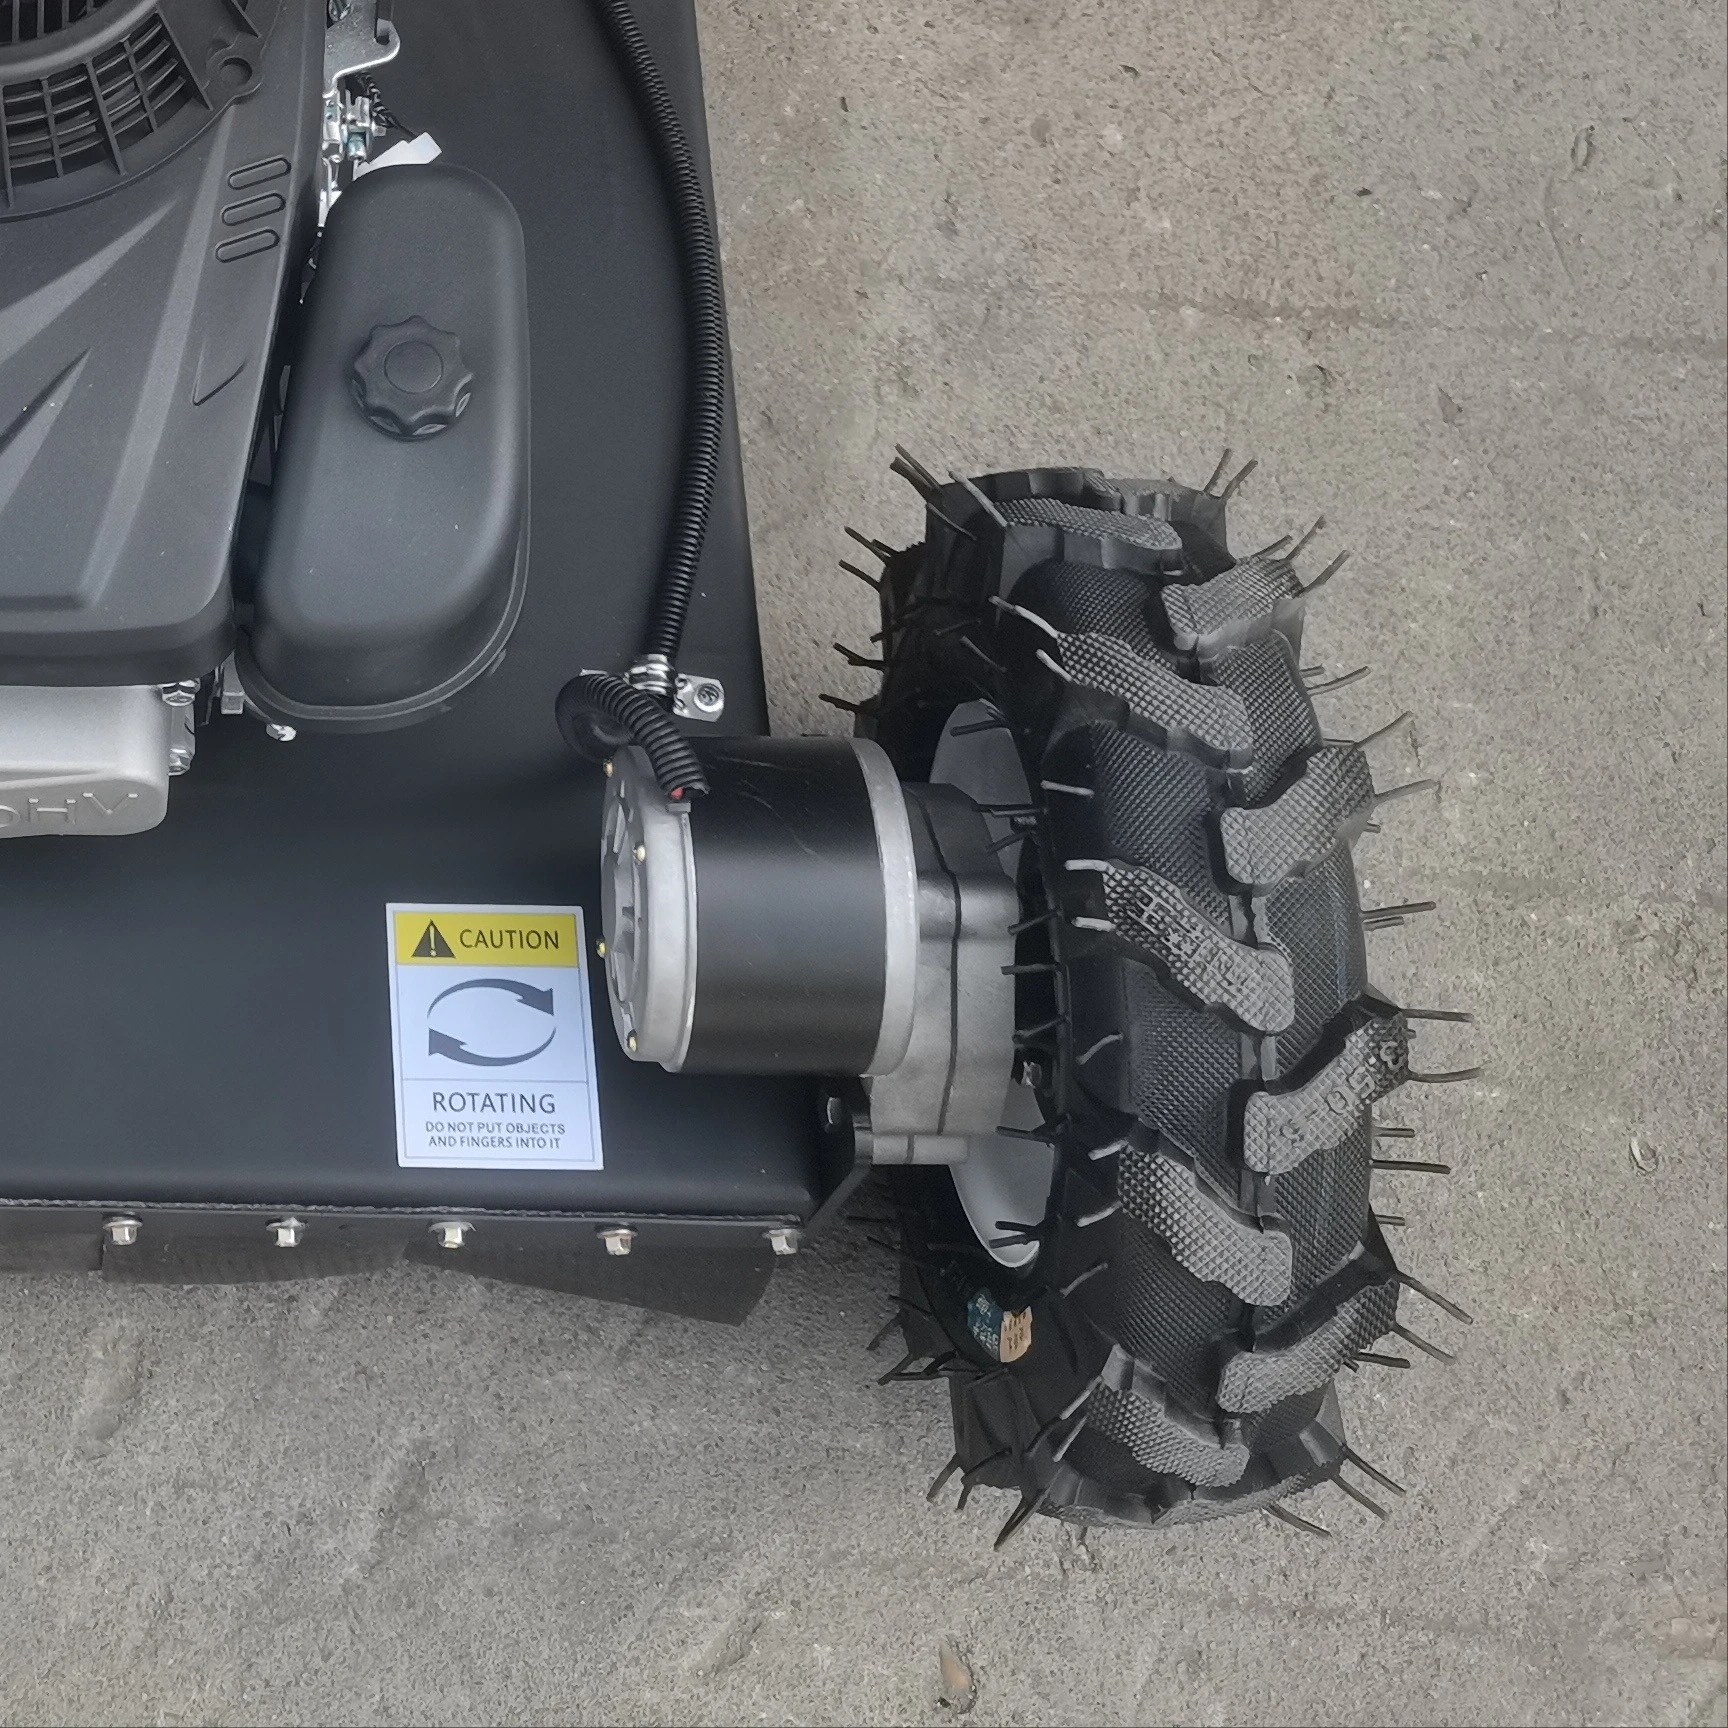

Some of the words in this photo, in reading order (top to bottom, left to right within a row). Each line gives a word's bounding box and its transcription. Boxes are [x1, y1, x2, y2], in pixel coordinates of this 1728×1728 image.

[459, 929, 560, 950] CAUTION
[432, 1091, 557, 1115] ROTATING
[425, 1121, 447, 1133] DO
[448, 1122, 475, 1134] NOT
[477, 1122, 504, 1134] PUT
[505, 1122, 566, 1135] OBJECTS
[428, 1136, 458, 1148] AND
[459, 1136, 513, 1149] FINGERS
[515, 1137, 547, 1149] INTO
[549, 1137, 561, 1150] IT
